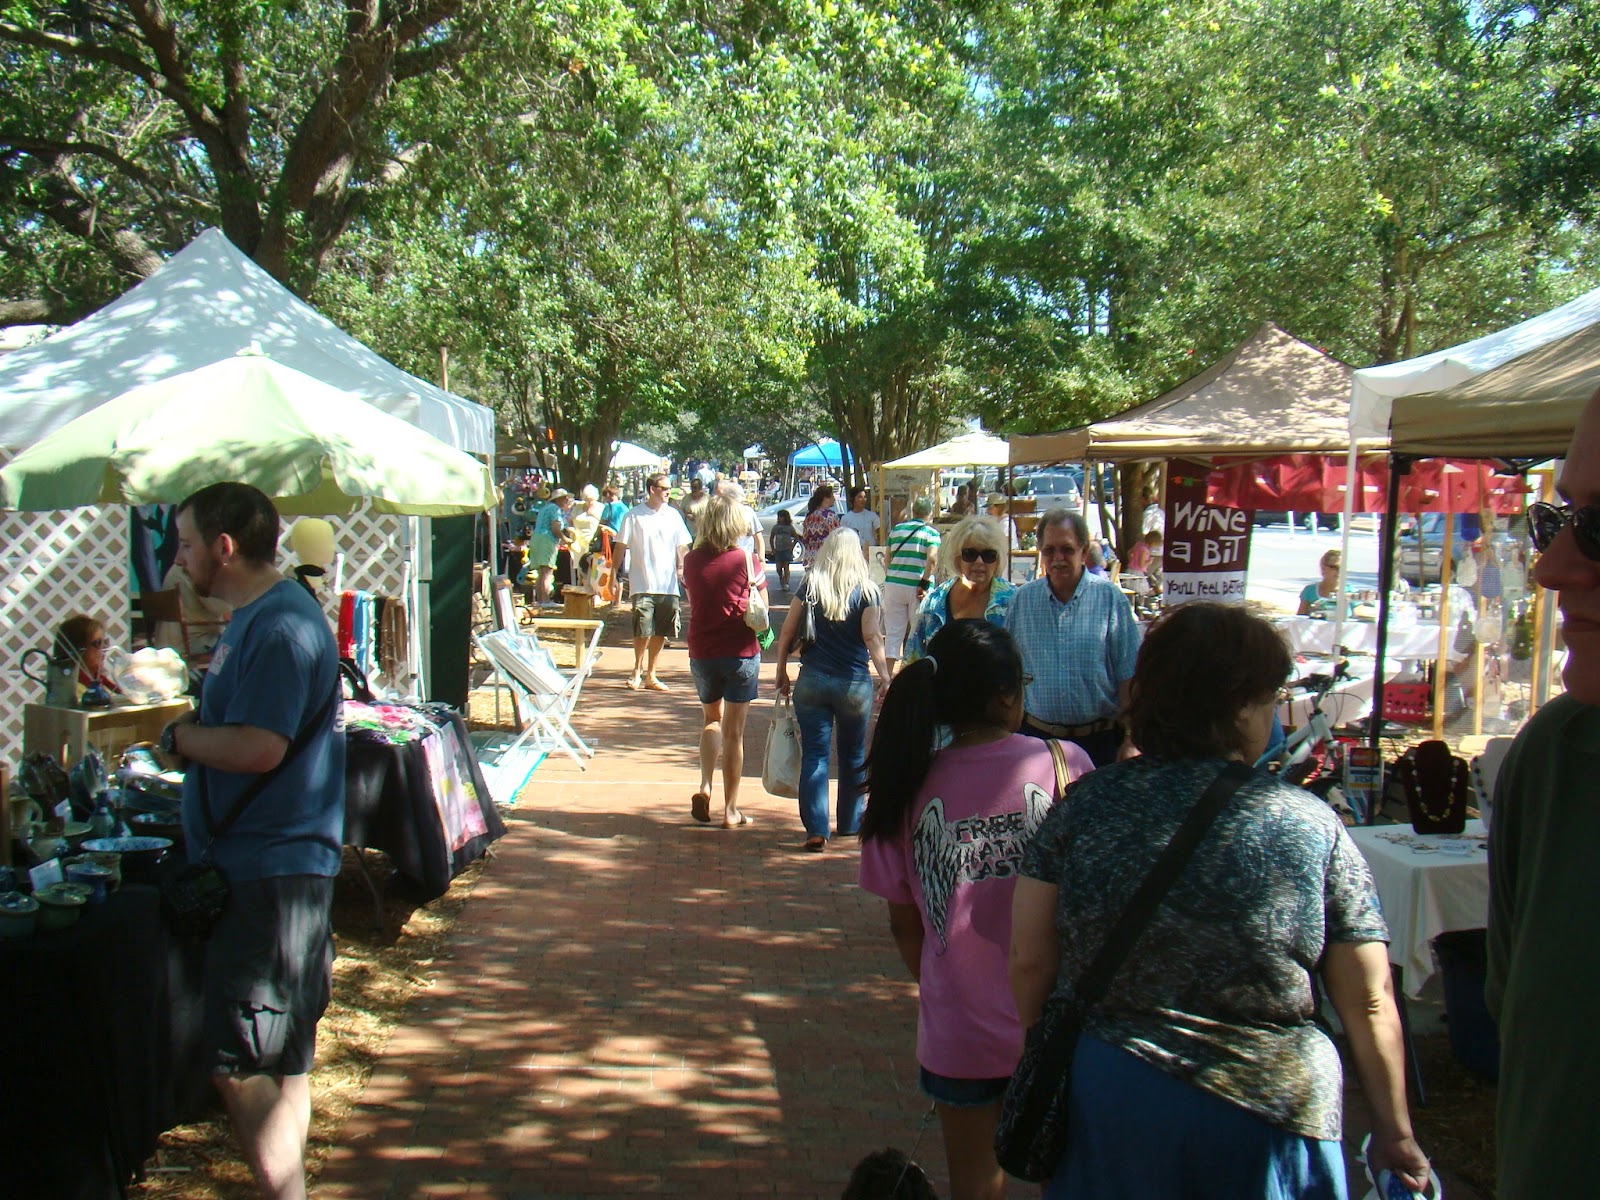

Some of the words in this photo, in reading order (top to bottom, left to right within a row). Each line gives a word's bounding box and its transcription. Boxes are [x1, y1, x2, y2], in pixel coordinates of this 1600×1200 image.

[1170, 541, 1192, 563] a
[1202, 535, 1247, 567] BiT
[954, 811, 1025, 842] FREE
